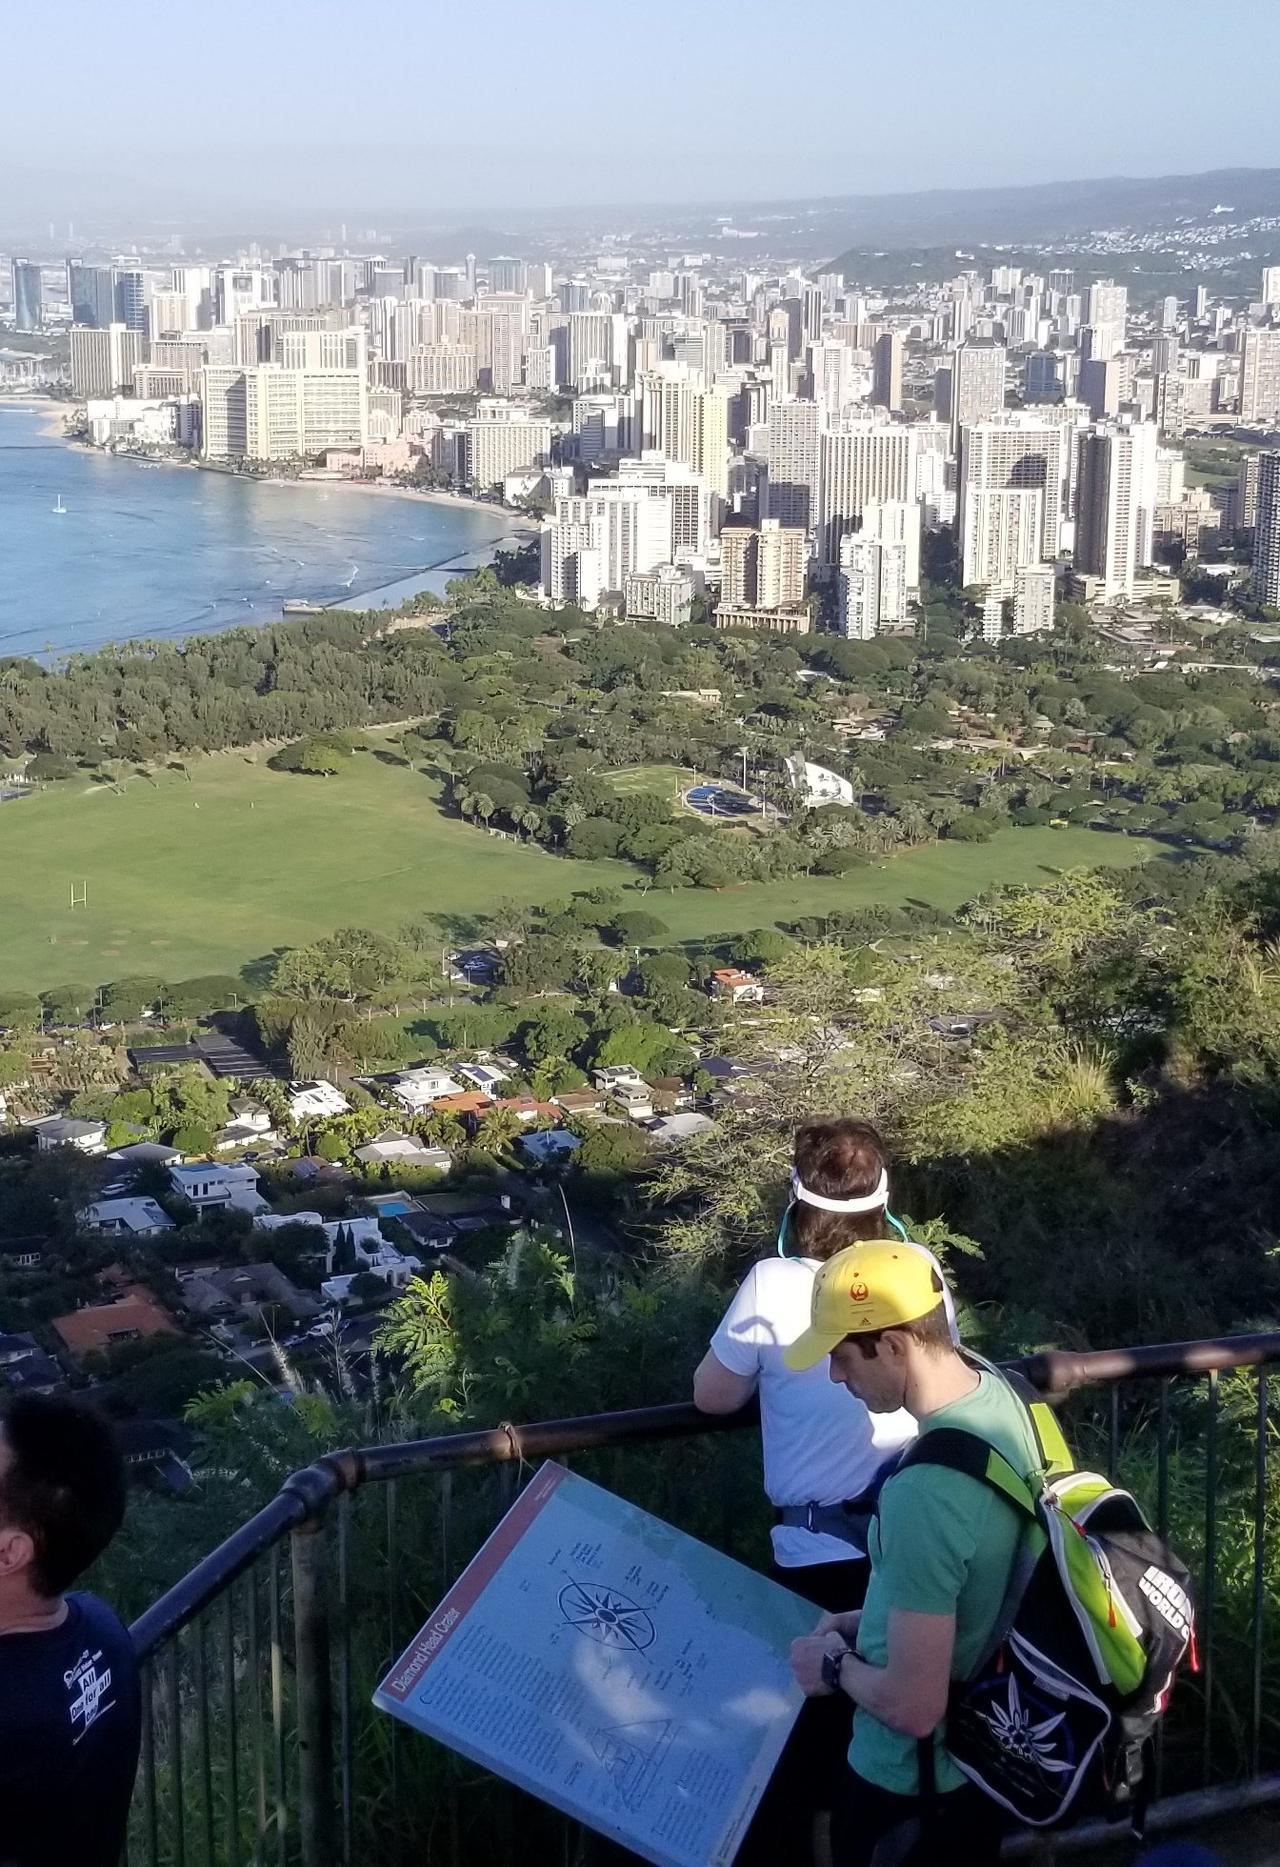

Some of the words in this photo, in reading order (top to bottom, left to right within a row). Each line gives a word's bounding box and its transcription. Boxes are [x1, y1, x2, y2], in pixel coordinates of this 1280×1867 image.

[1138, 1576, 1185, 1629] WORLD
[391, 1650, 429, 1692] Diamond
[418, 1629, 444, 1656] Head
[434, 1607, 461, 1634] Crater
[82, 1669, 96, 1691] All
[99, 1671, 111, 1693] all
